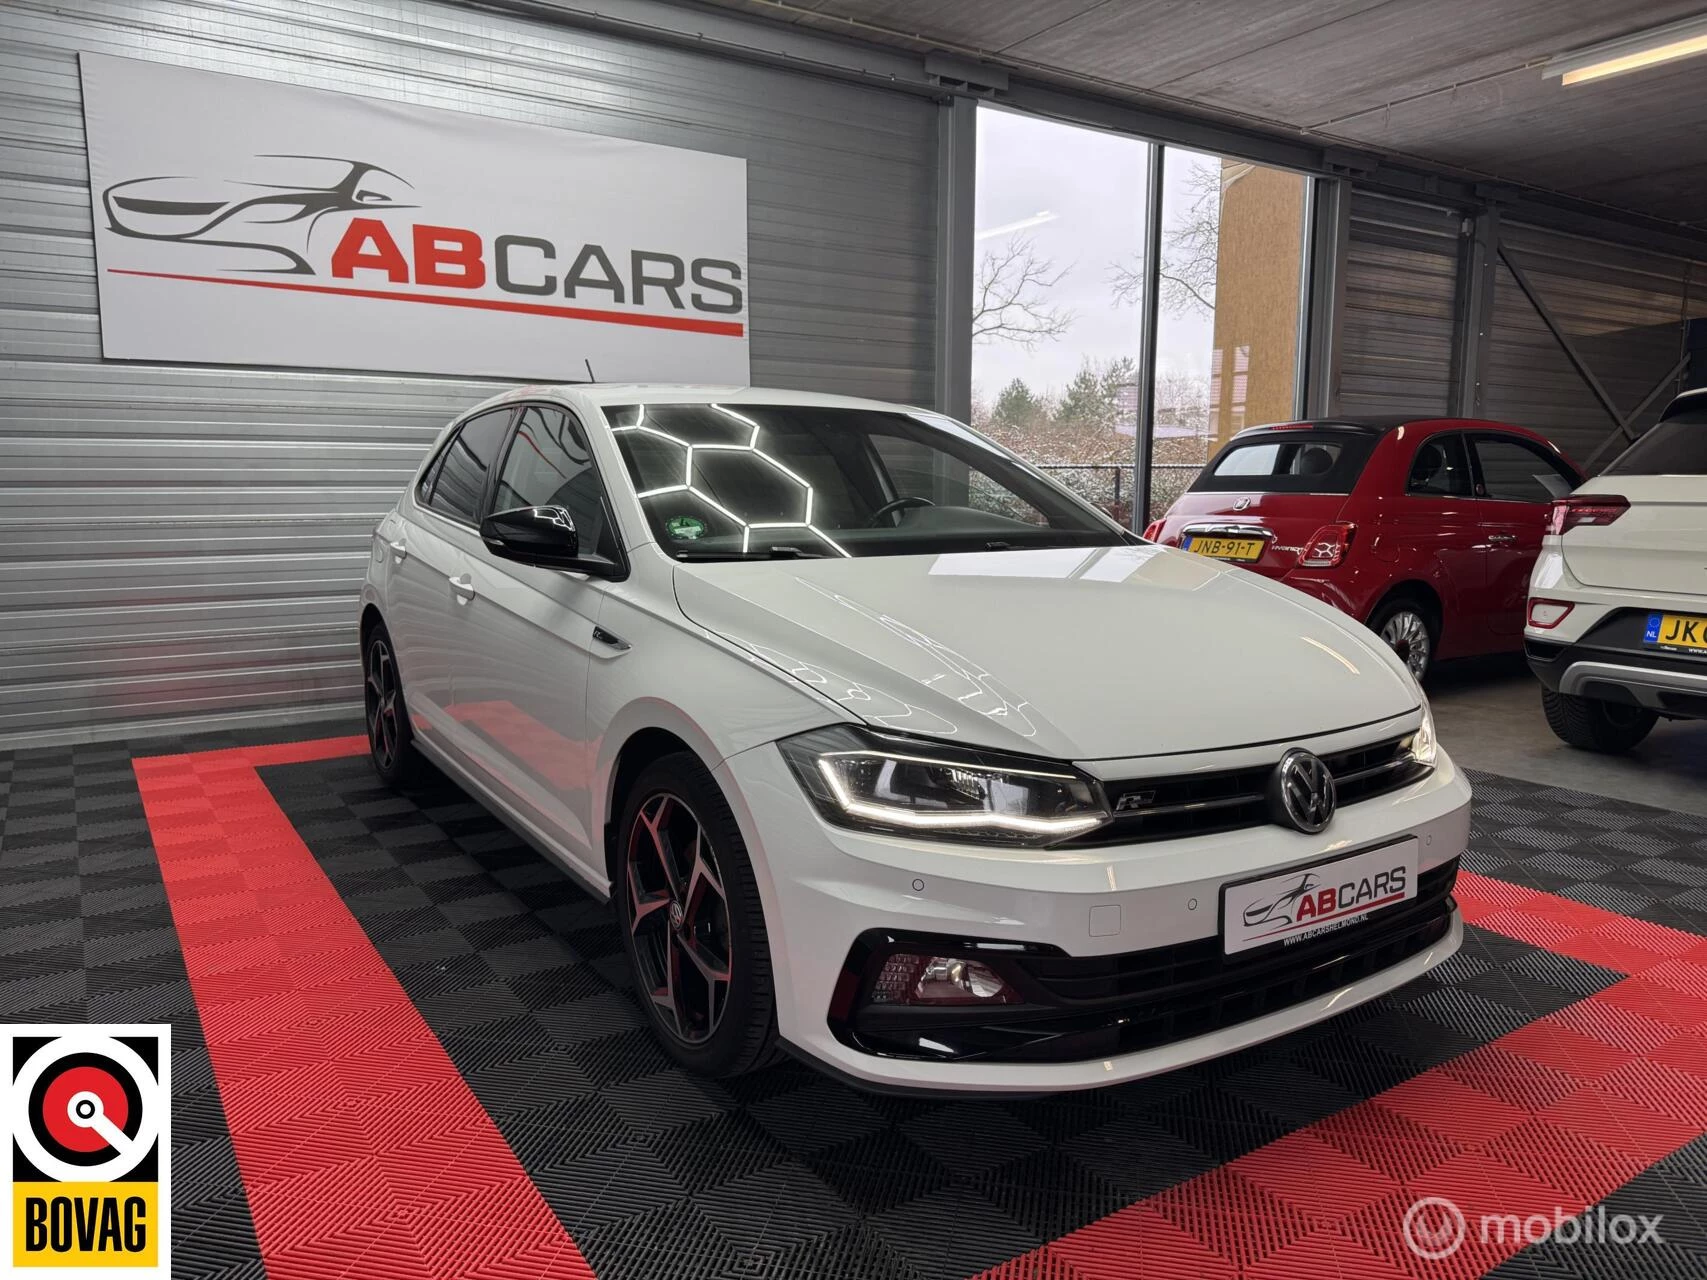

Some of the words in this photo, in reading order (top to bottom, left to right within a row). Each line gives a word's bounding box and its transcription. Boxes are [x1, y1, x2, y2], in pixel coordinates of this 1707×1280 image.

[331, 217, 744, 315] ABCARS
[1194, 540, 1256, 556] JNB-91-T
[1646, 630, 1657, 638] NL
[1296, 865, 1407, 922] ABCARS
